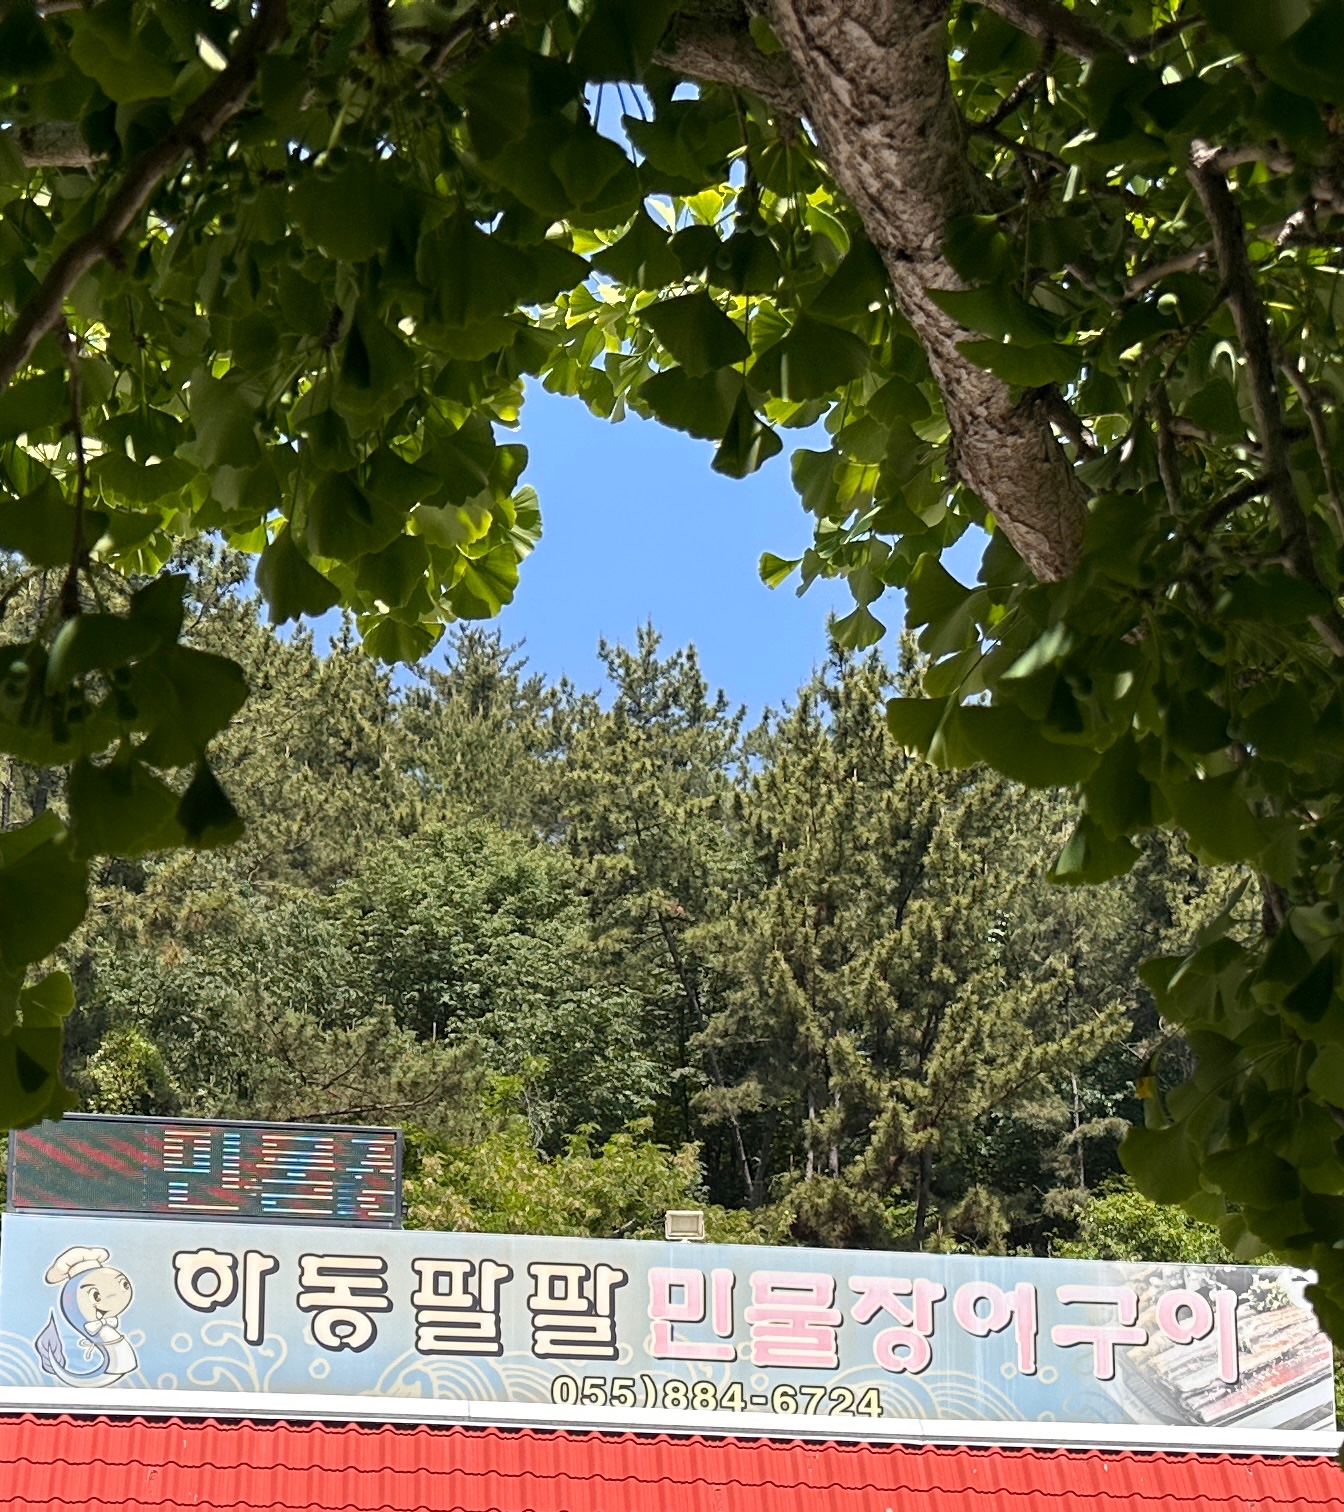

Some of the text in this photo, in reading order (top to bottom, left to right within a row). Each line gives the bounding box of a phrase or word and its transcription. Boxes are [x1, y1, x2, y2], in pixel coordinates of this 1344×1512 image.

[171, 1247, 1242, 1387] 하동팔팔 민물장어구이
[551, 1373, 883, 1420] 055)884-6724
